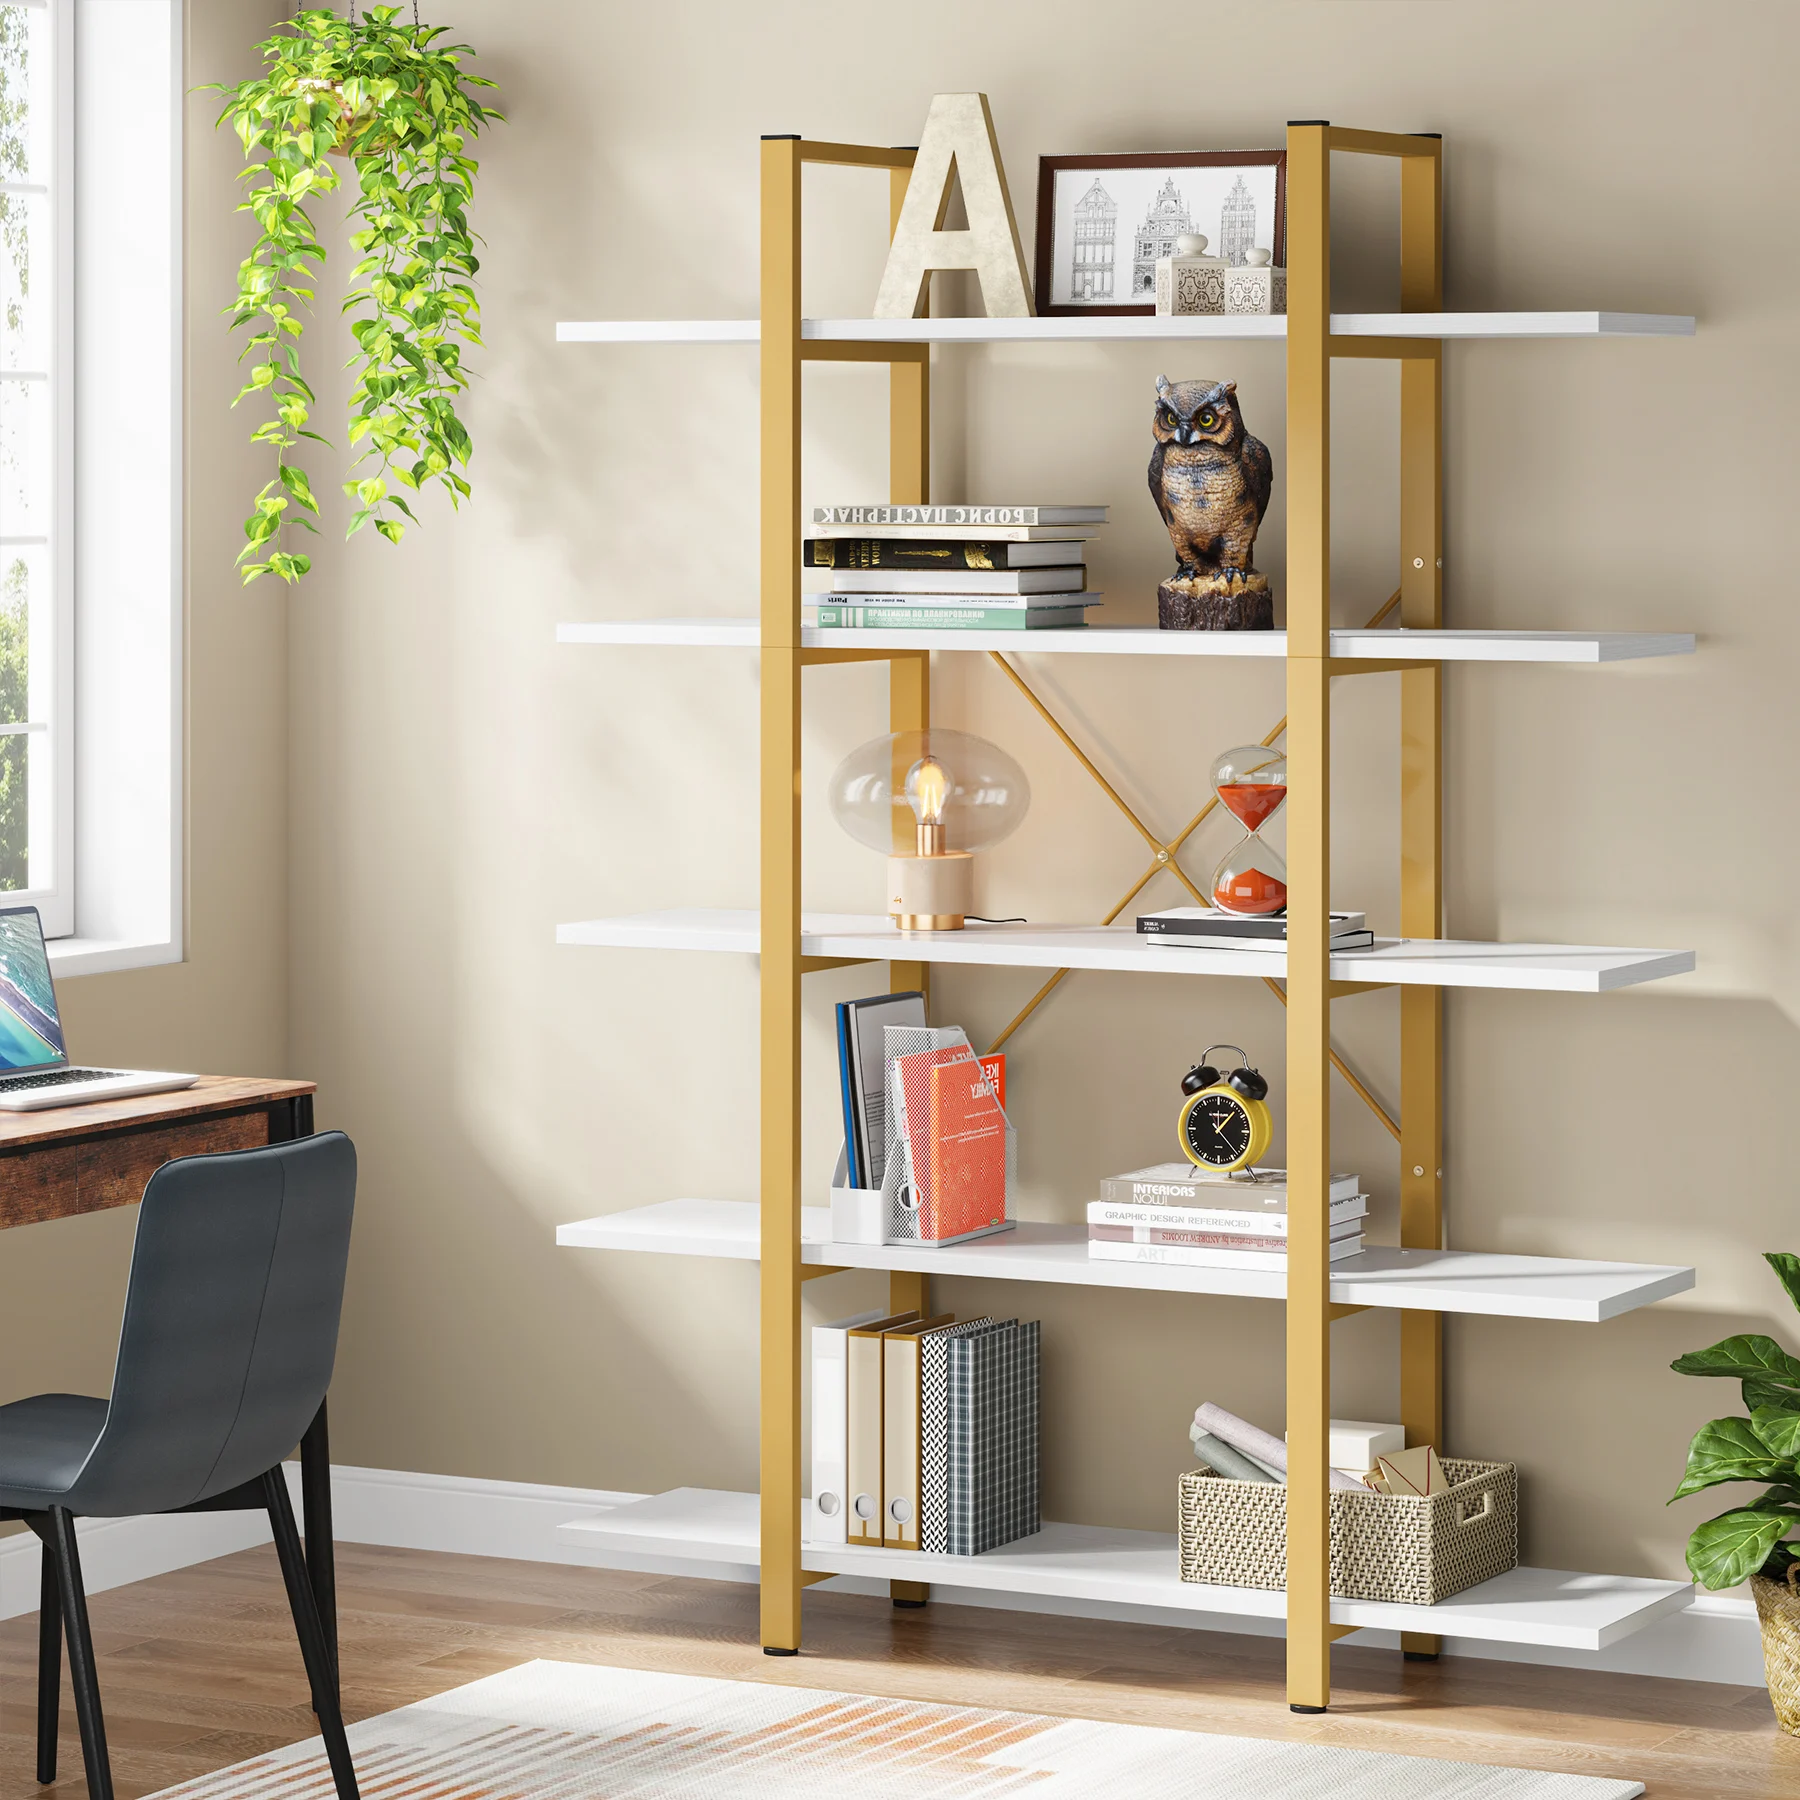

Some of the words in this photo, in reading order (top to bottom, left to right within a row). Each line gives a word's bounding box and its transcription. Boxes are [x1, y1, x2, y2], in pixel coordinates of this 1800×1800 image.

[820, 507, 947, 523] ПАСТЕРНАК
[955, 507, 1025, 524] БОРИС
[868, 609, 911, 618] ПРАКТИКУМ
[912, 610, 923, 618] ПО
[1133, 1183, 1196, 1198] INTERIORS
[1133, 1193, 1168, 1205] NOW!
[1105, 1210, 1147, 1221] GRAPHIC
[1150, 1214, 1185, 1224] DESIGN
[1188, 1217, 1251, 1228] REFERENCED
[1161, 1232, 1189, 1242] LOOMIS
[1190, 1234, 1220, 1244] ANDREW
[1221, 1234, 1229, 1245] by
[1230, 1237, 1264, 1247] Illustration
[1136, 1247, 1168, 1261] ART
